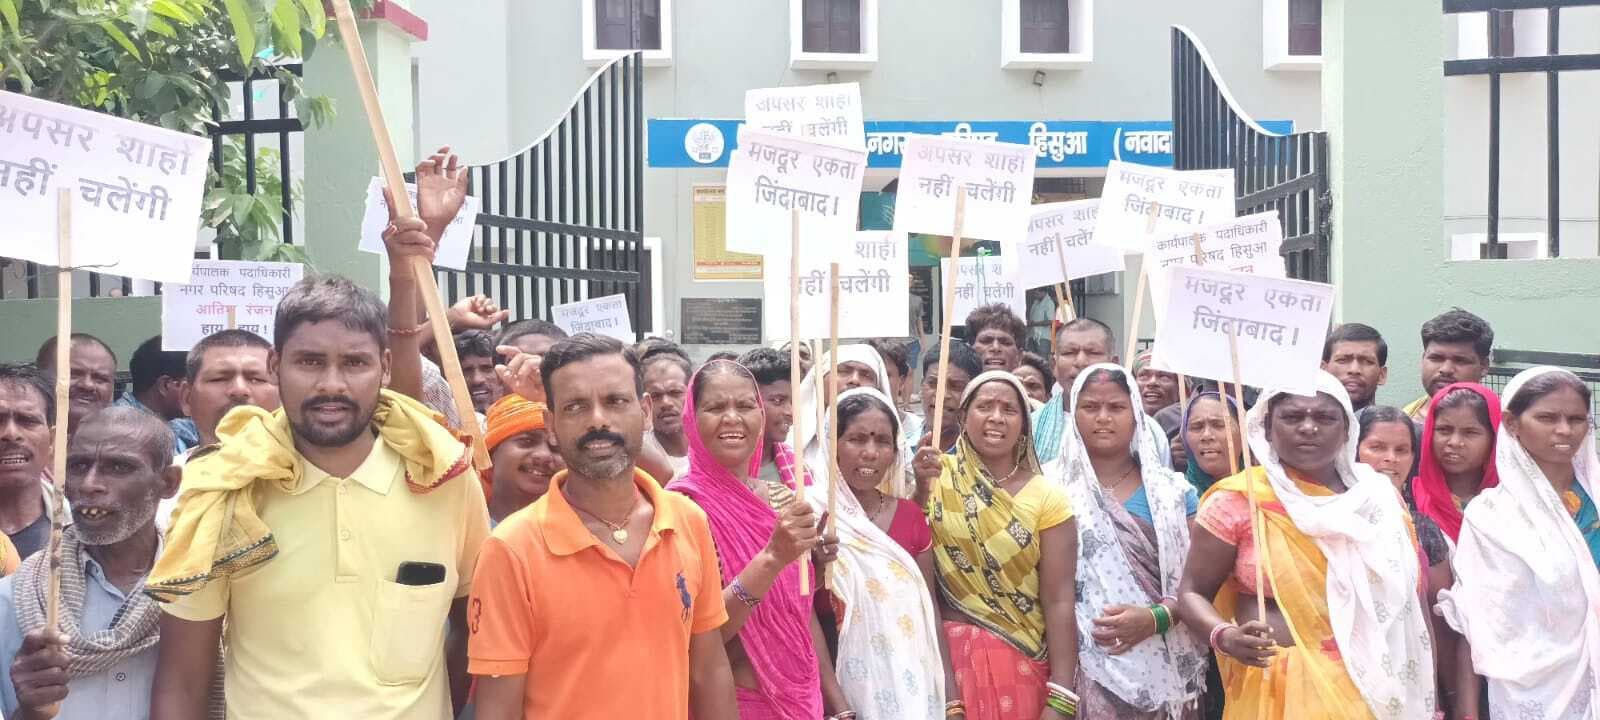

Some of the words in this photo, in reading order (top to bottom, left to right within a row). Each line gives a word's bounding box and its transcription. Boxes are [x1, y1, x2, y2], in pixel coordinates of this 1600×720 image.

[1028, 122, 1088, 163] हिसुआ
[750, 142, 801, 173] मजदूर
[813, 155, 858, 179] एकता
[78, 176, 172, 221] चलेंगी
[918, 174, 953, 197] नहीं
[965, 178, 1016, 204] चलेंगी
[1216, 219, 1267, 240] पदाधिकारी
[1028, 235, 1055, 255] नहीं
[1230, 241, 1266, 259] हिसुआ
[240, 264, 290, 279] पदाधिकारी
[839, 268, 891, 293] चलेंगी
[210, 281, 246, 297] परिषद
[1184, 275, 1248, 305] मजदूर
[1264, 287, 1323, 313] एकता
